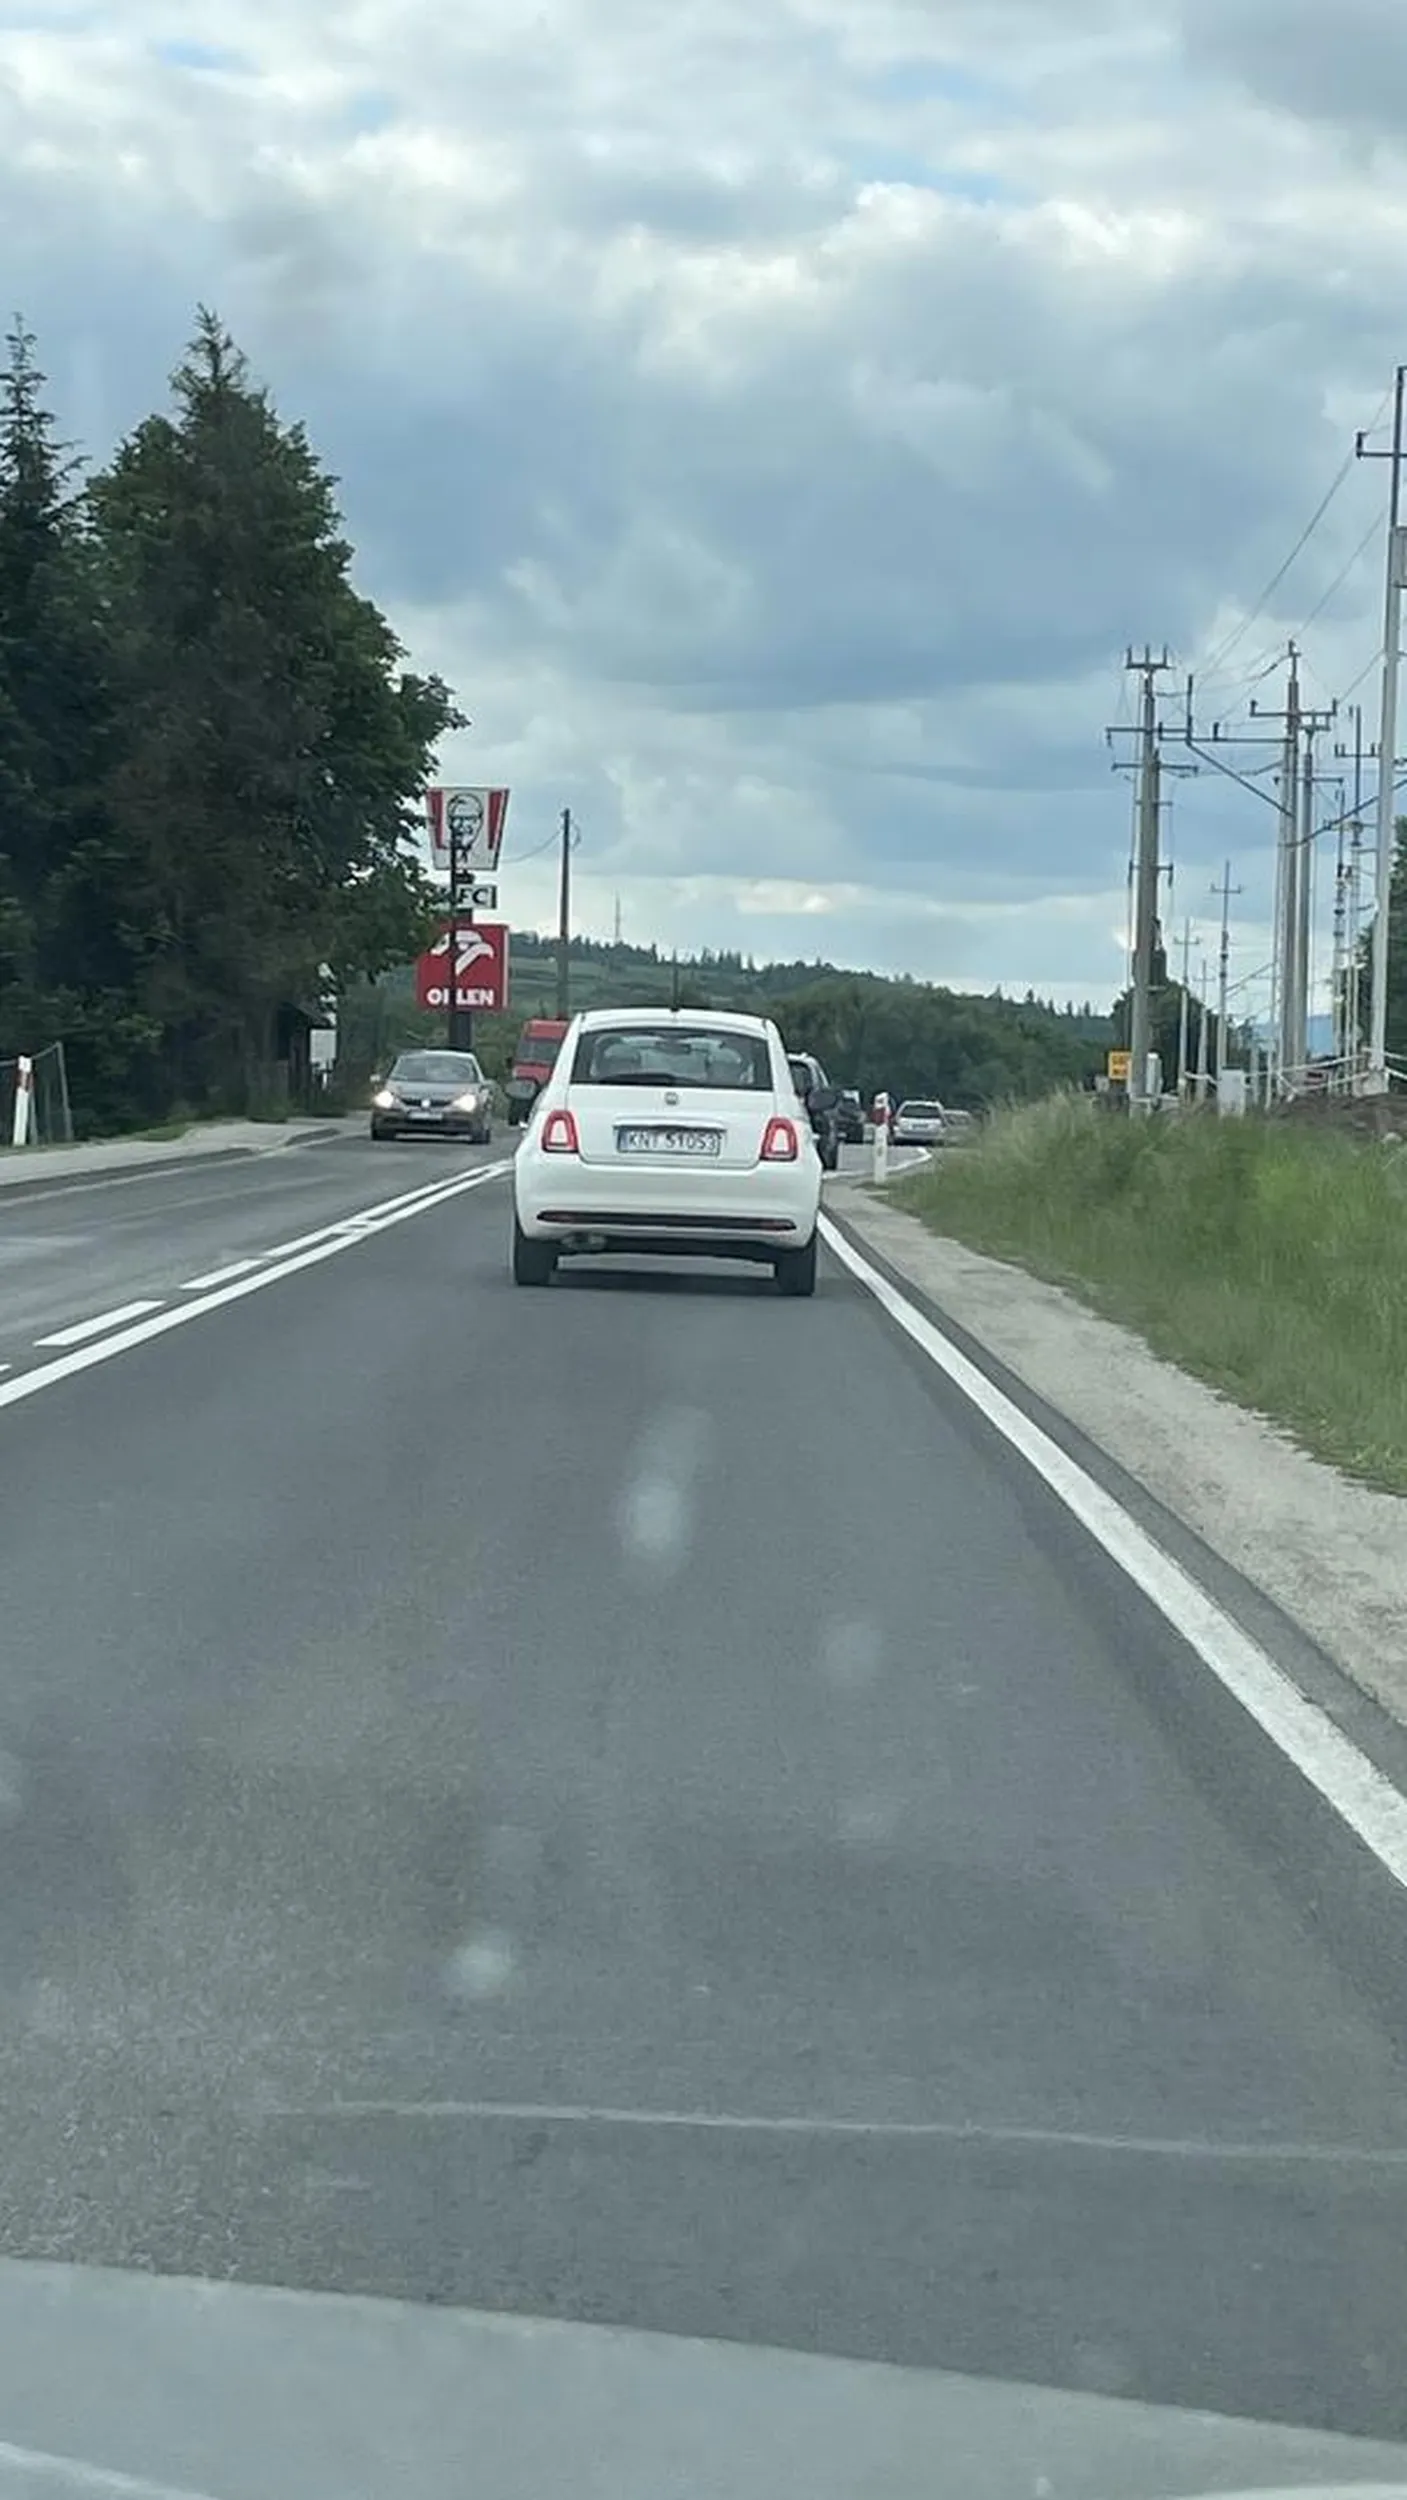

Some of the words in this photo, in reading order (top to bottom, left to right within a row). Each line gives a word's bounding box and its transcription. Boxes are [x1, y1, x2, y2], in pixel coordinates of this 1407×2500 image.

[443, 887, 489, 905] FC
[629, 1131, 659, 1149] KNT
[664, 1132, 716, 1151] 51053
